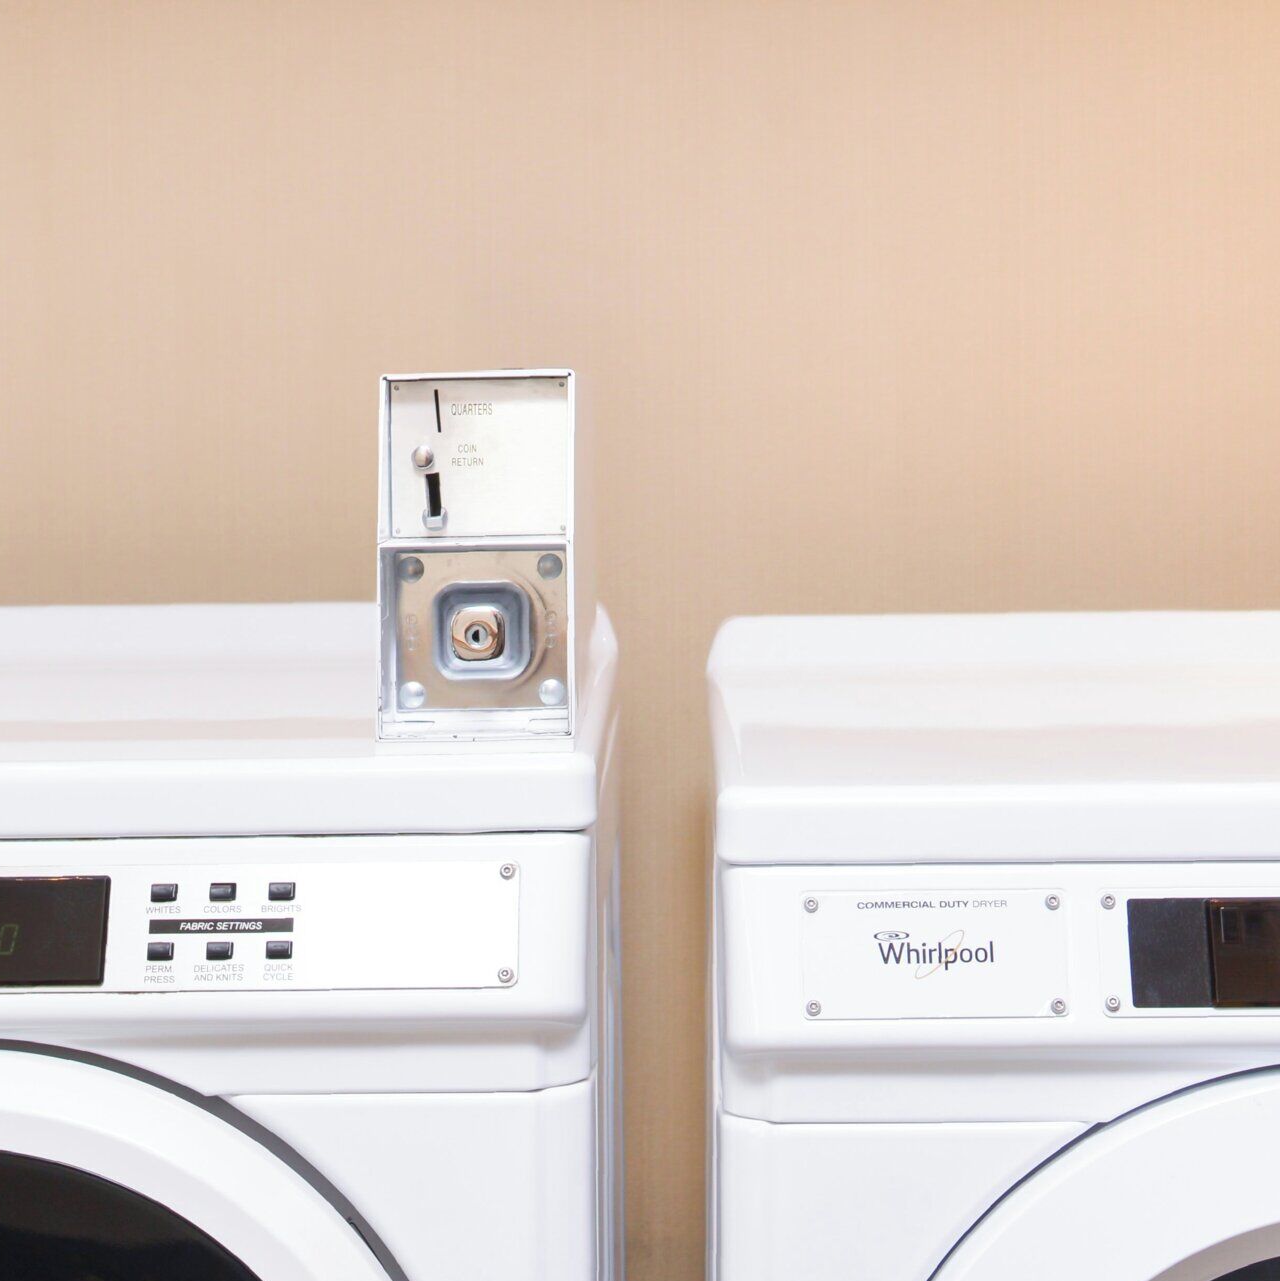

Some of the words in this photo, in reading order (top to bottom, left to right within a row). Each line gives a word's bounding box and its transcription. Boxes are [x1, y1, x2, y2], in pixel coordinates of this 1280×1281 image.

[451, 403, 493, 416] QUARTERS
[457, 443, 477, 454] COIN
[451, 457, 484, 467] RETURN
[261, 904, 302, 913] BRIGHTS
[856, 900, 936, 910] COMMERCIAL
[939, 900, 969, 908] DUTY
[972, 899, 1008, 908] DRYER
[145, 905, 181, 914] WHITES
[203, 905, 242, 914] COLORS
[179, 921, 214, 931] FABRIC
[216, 921, 263, 931] SETTINGS
[878, 940, 995, 971] Whirlpool
[145, 965, 172, 974] PERM
[193, 963, 245, 973] DELICATES
[264, 963, 293, 972] QUICK
[144, 975, 176, 984] PRESS
[194, 973, 213, 982] AND
[215, 973, 244, 982] KNITS
[262, 972, 294, 981] CYCLE
